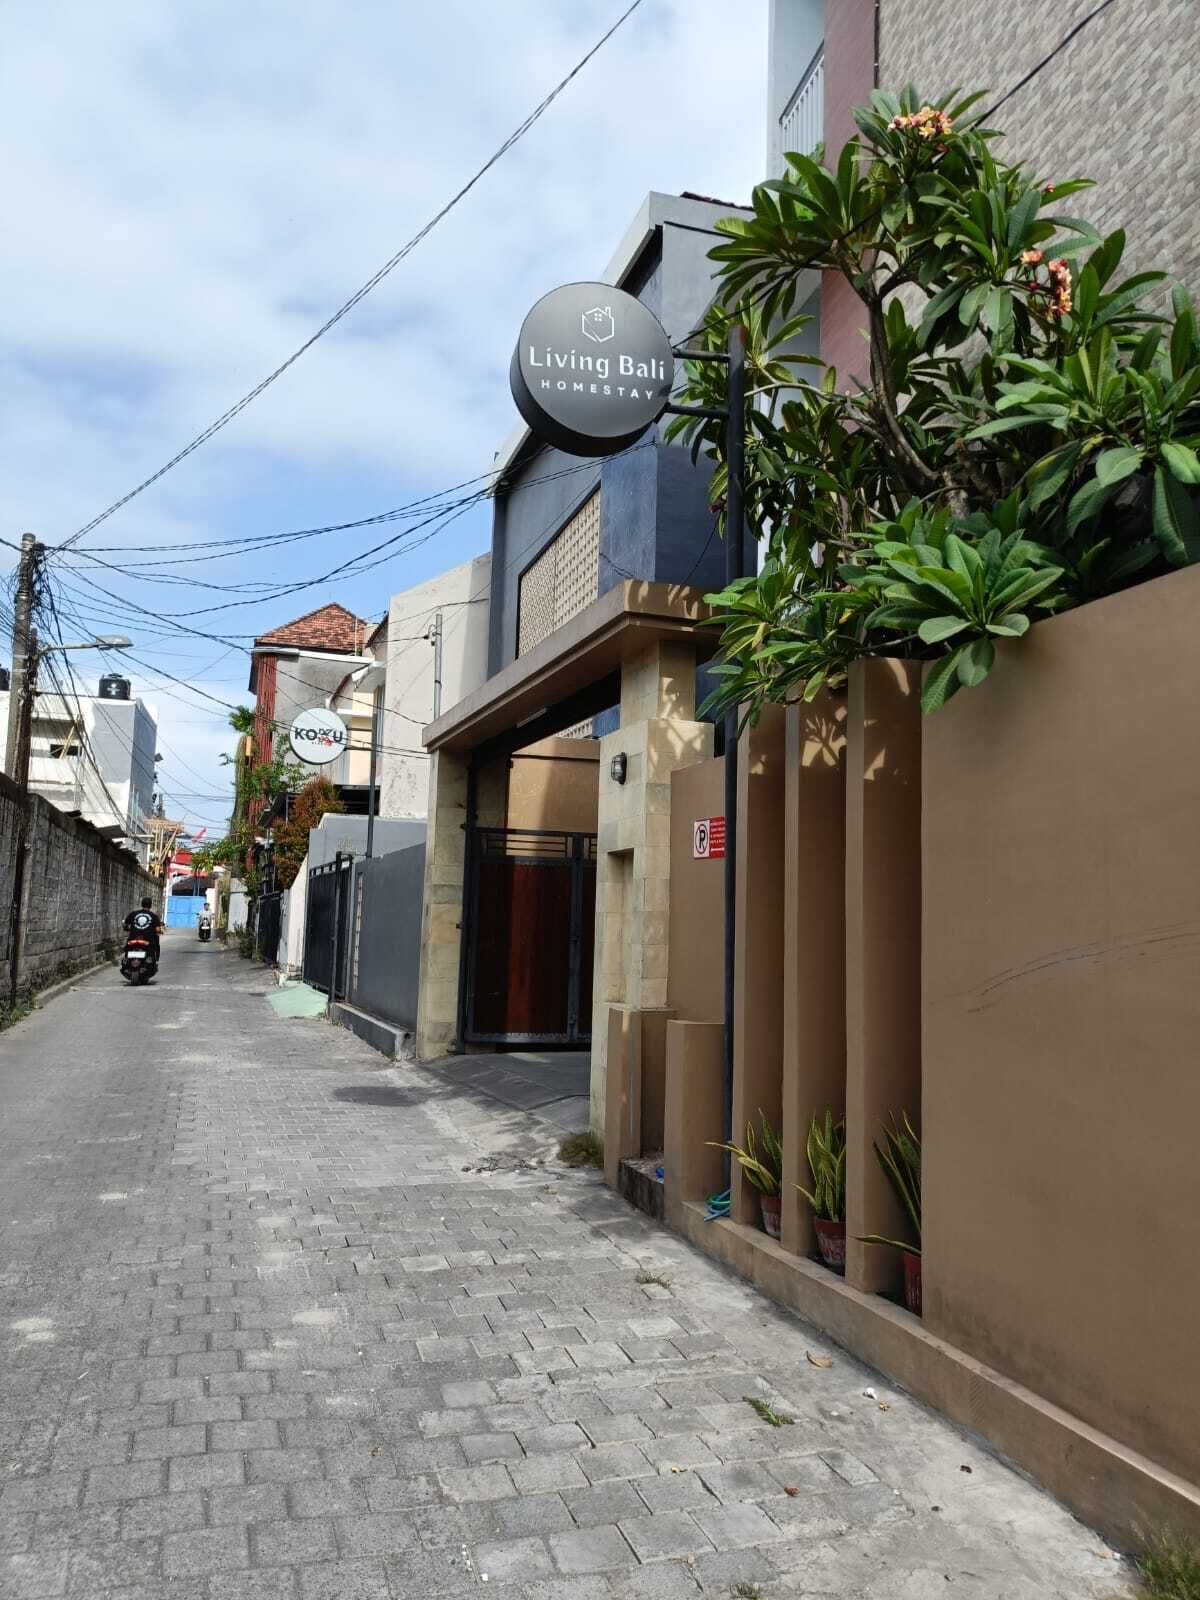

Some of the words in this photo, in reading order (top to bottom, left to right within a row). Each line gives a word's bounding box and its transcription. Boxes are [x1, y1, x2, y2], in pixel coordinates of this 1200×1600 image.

[529, 345, 609, 379] Living
[619, 355, 665, 380] Bali
[541, 379, 655, 401] HOMESTAY
